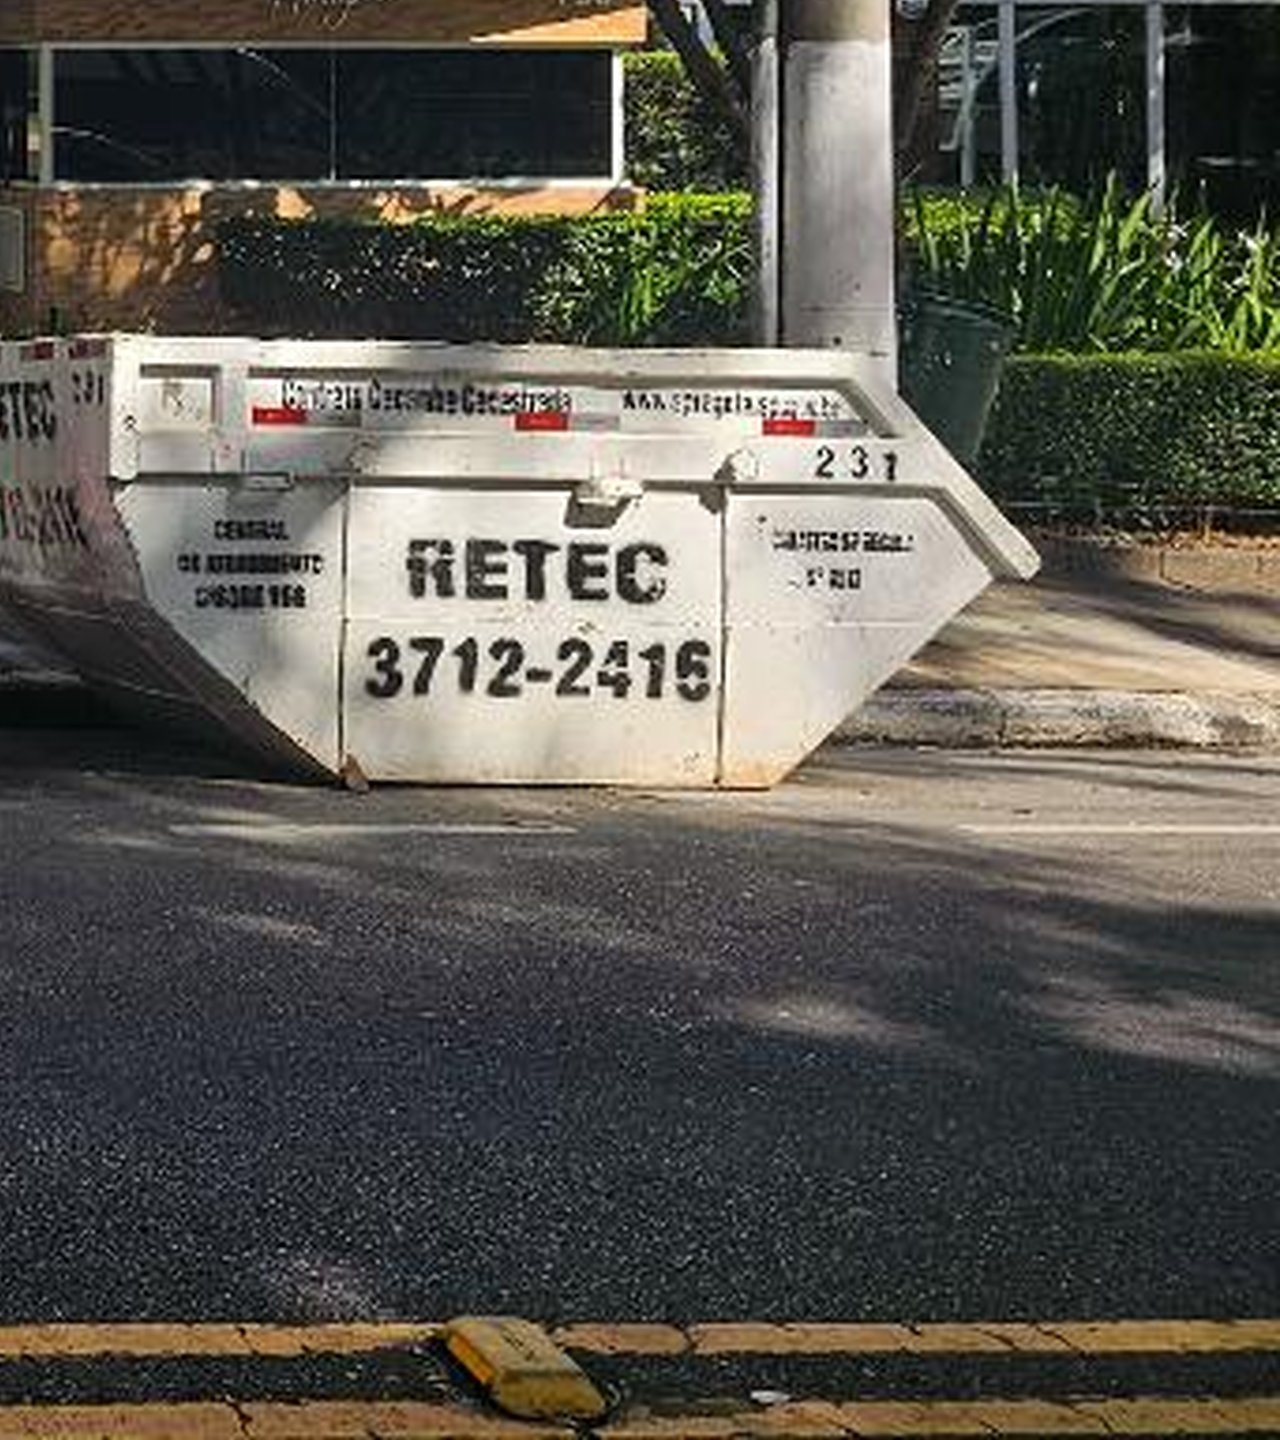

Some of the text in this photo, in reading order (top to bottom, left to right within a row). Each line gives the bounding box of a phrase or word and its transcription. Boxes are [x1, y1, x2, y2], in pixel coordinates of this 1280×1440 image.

[815, 445, 899, 481] 231
[406, 539, 669, 604] RETEC
[364, 637, 712, 702] 3712-2416
